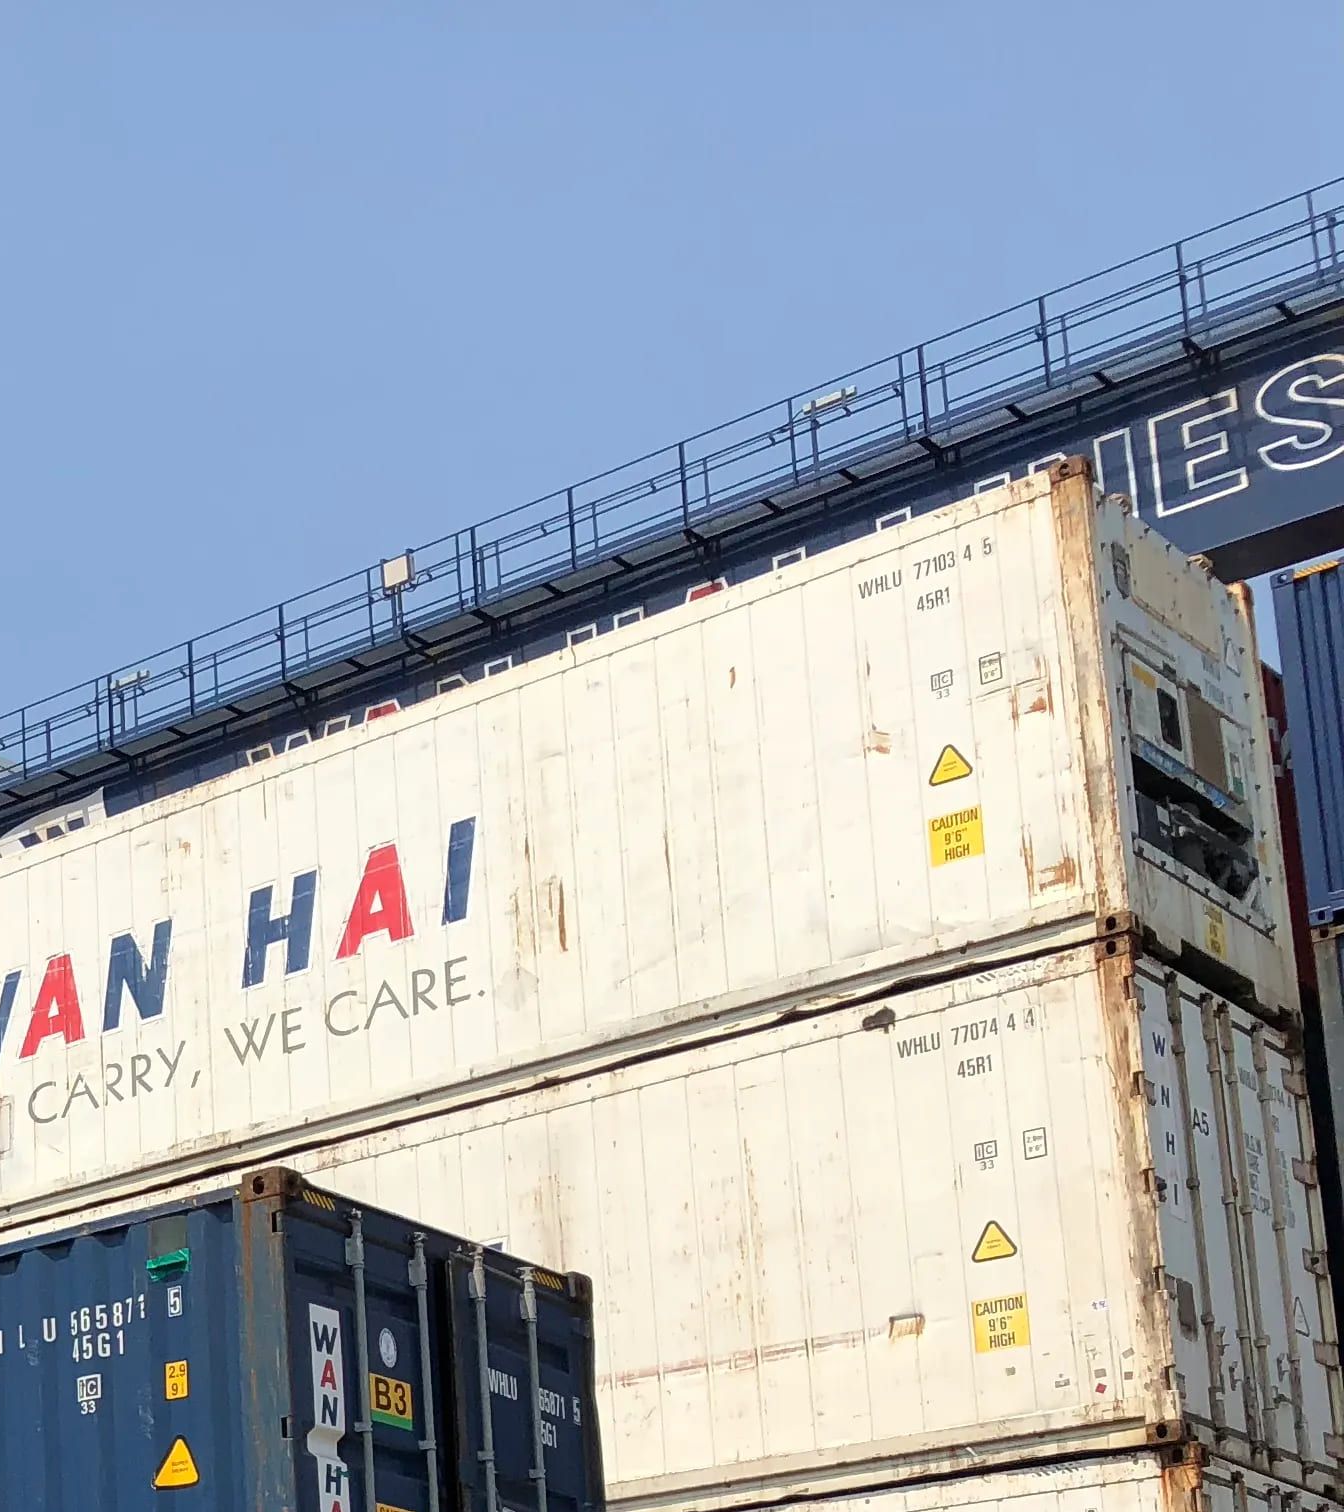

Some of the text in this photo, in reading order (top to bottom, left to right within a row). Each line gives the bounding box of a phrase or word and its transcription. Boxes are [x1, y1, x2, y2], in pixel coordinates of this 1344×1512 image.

[858, 569, 902, 601] WHLU
[913, 552, 956, 582] 77103
[983, 536, 993, 556] 5
[916, 586, 952, 613] 45R1
[932, 807, 978, 832] CAUTION
[945, 844, 970, 862] HIGH
[242, 815, 476, 989] HAI
[26, 956, 486, 1124] CARRY, WE CARE.
[897, 1032, 942, 1059] WHLU
[951, 1018, 998, 1047] 77074
[1007, 1012, 1016, 1032] 4
[957, 1055, 993, 1079] 45R1
[1192, 1108, 1210, 1137] A5
[979, 1160, 995, 1171] 33
[169, 1286, 181, 1316] 5
[976, 1295, 1024, 1317] CAUTION
[72, 1329, 125, 1363] 45G1
[989, 1333, 1016, 1349] HIGH
[312, 1320, 340, 1428] WAN
[81, 1401, 96, 1415] 33
[374, 1376, 407, 1416] B3
[487, 1367, 518, 1401] WHLU
[572, 1397, 581, 1425] 5
